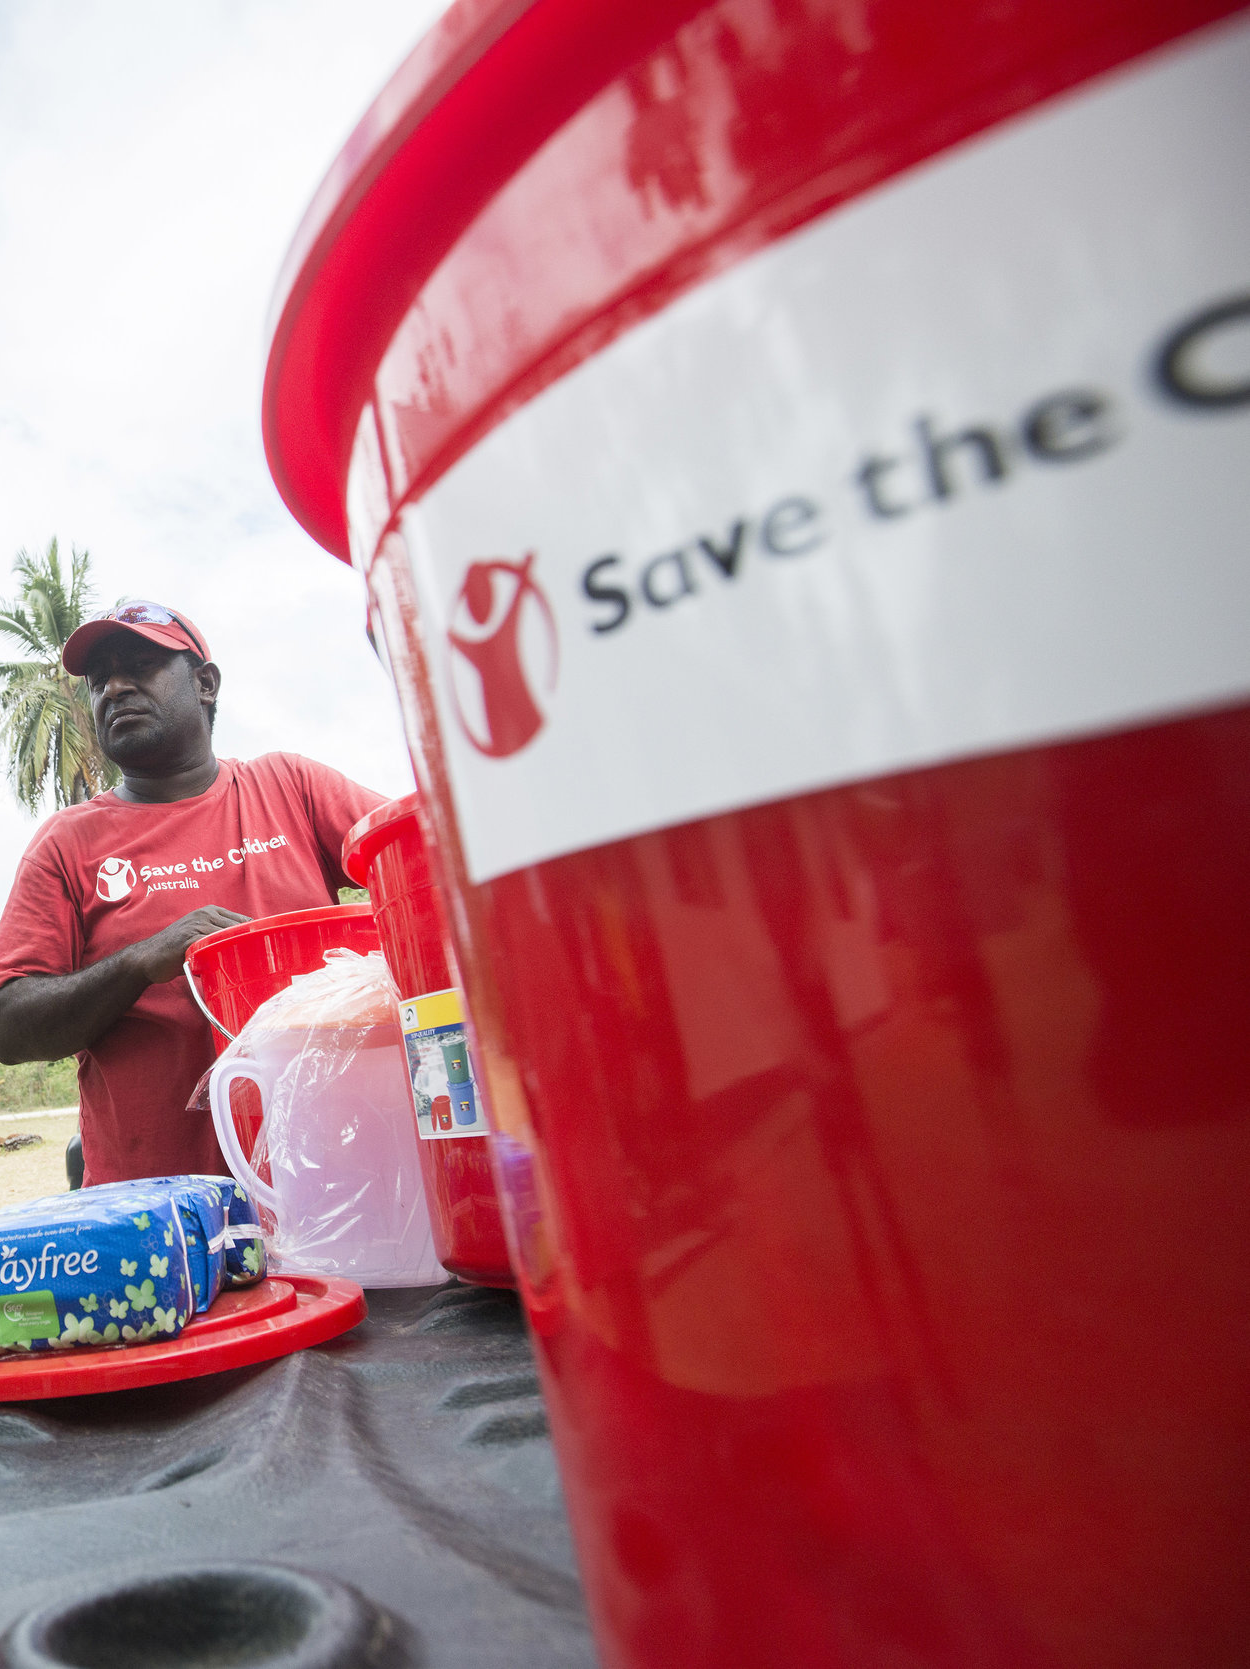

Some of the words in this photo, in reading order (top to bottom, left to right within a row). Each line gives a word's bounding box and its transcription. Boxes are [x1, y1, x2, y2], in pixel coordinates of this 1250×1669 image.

[579, 493, 826, 638] Save
[856, 386, 1126, 522] the
[140, 862, 188, 882] Save
[191, 856, 225, 873] the
[146, 877, 200, 897] Australia
